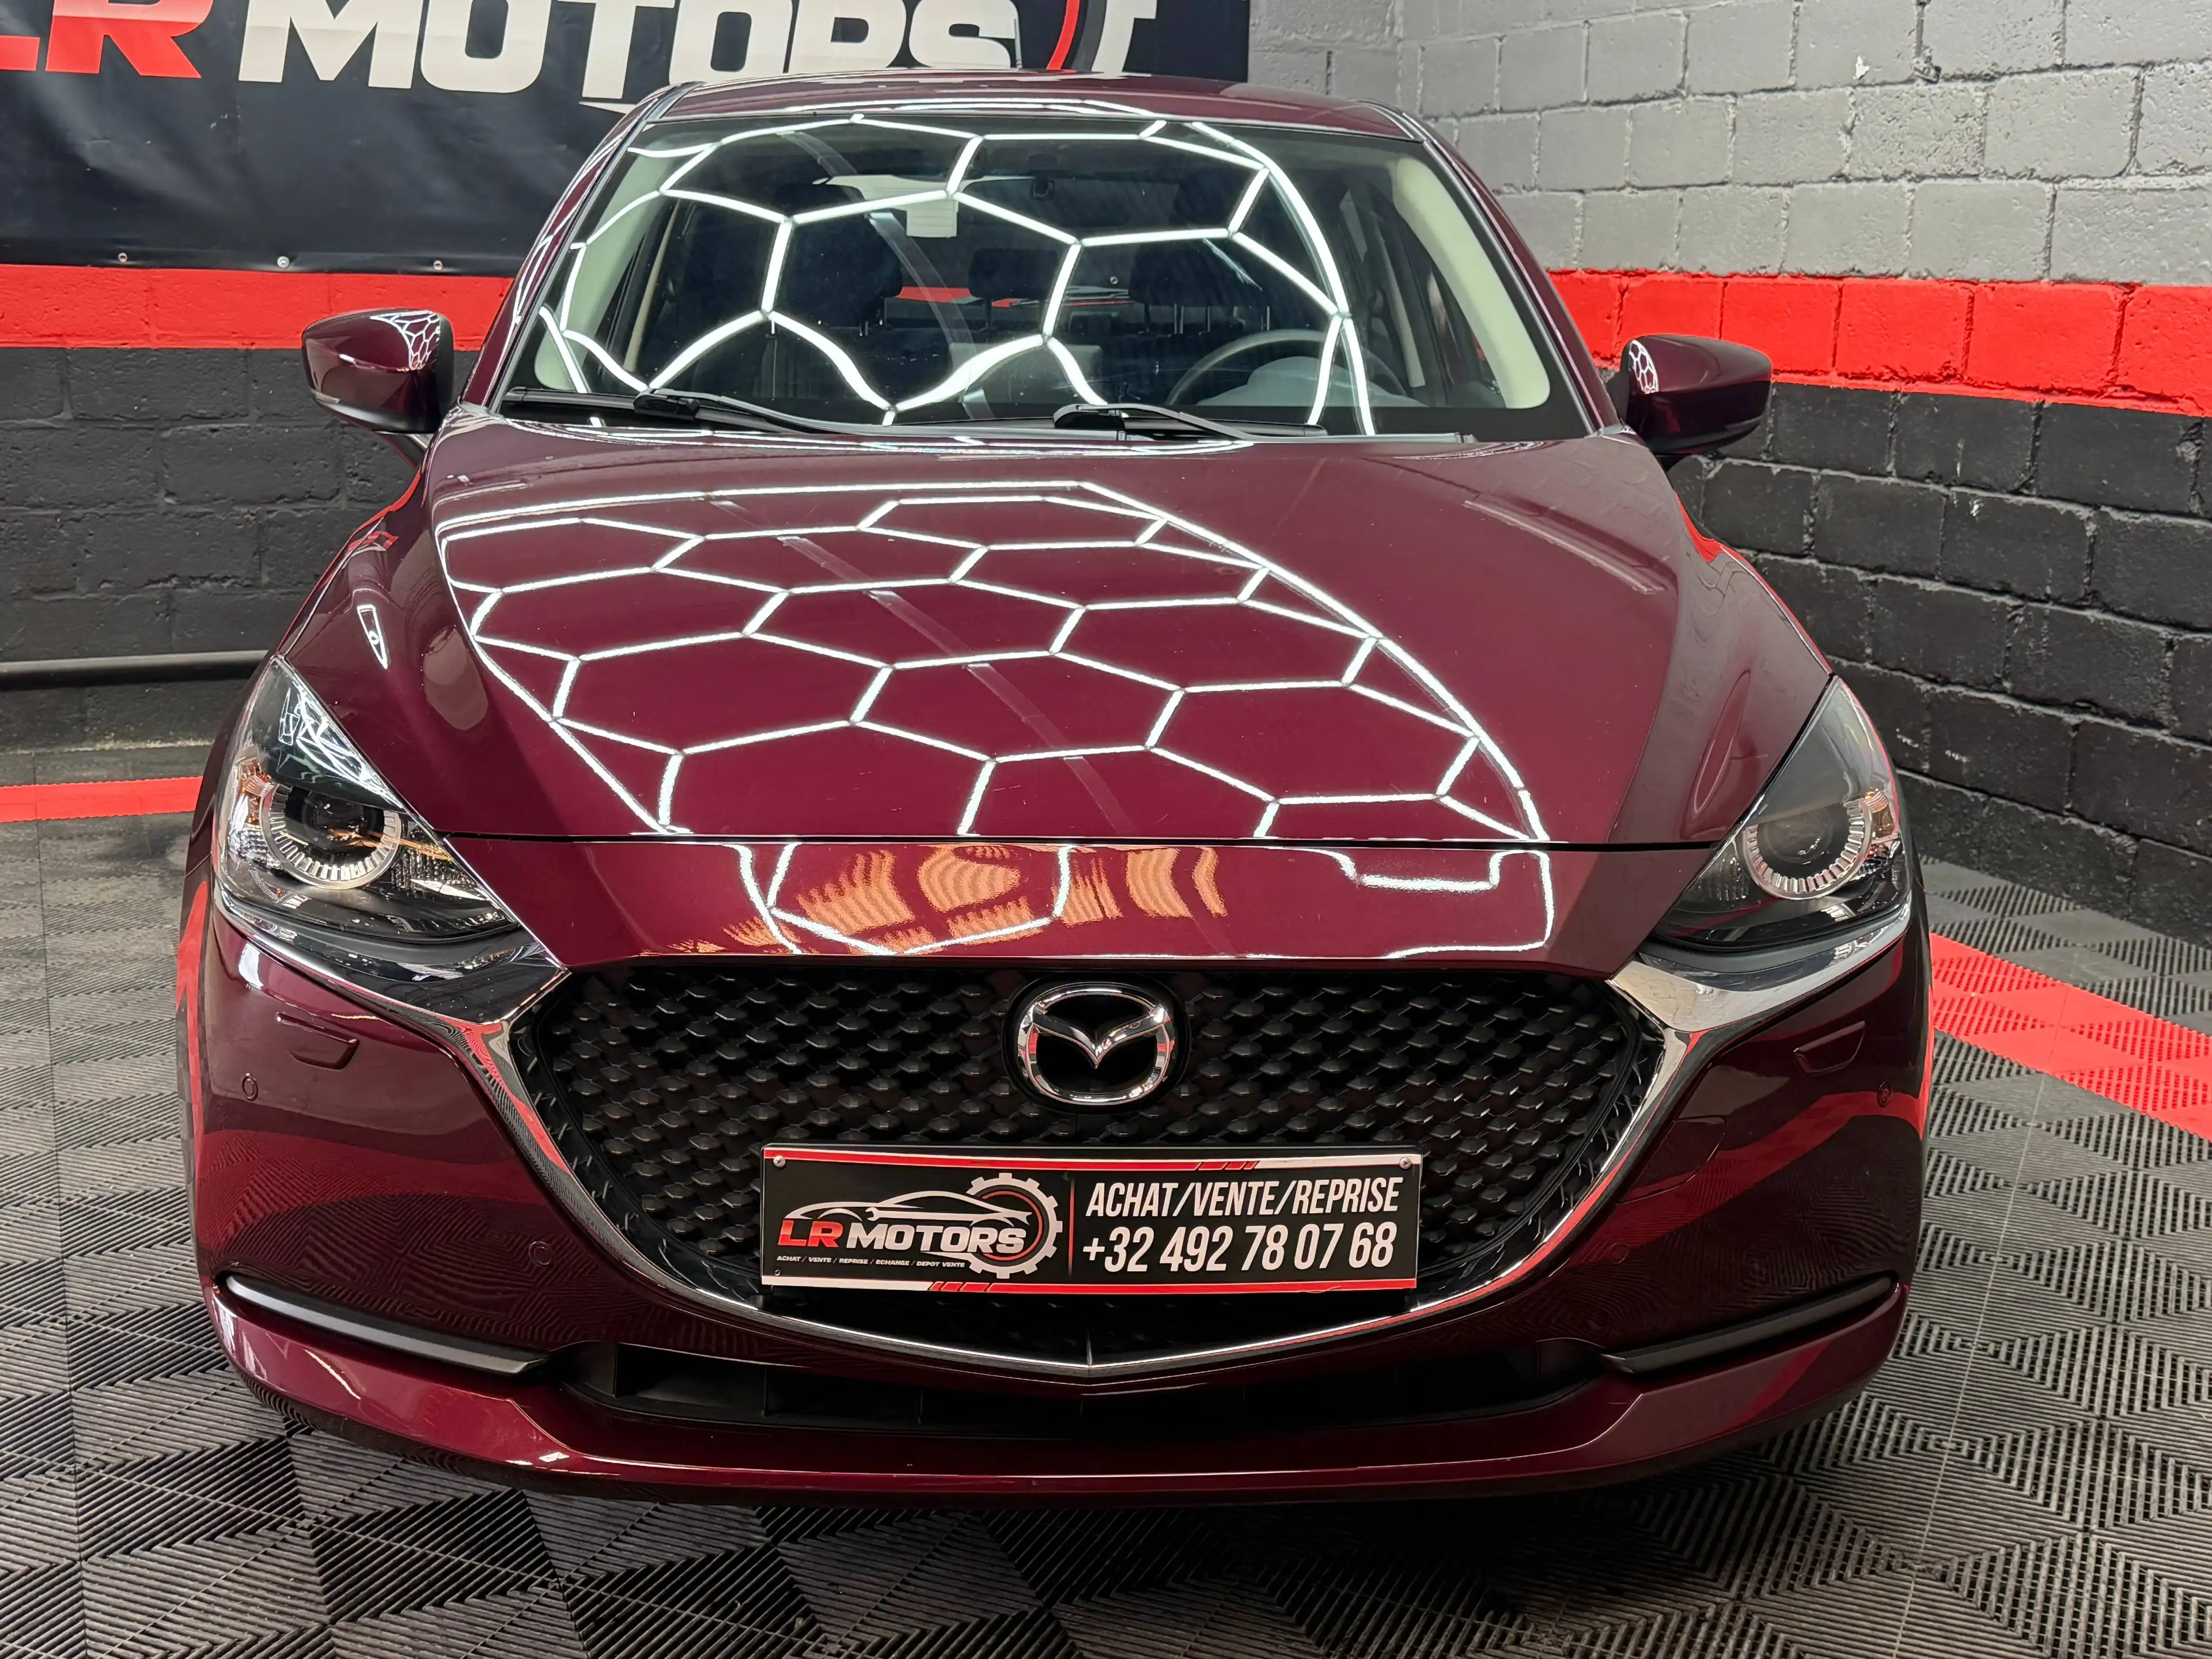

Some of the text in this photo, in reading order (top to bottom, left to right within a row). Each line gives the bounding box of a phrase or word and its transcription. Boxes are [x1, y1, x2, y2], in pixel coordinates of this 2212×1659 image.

[1085, 1177, 1404, 1217] ACHAT/VENTE/REPRISE
[778, 1219, 1027, 1253] LR MOTORS
[1082, 1221, 1397, 1272] +32 492 78 07 68
